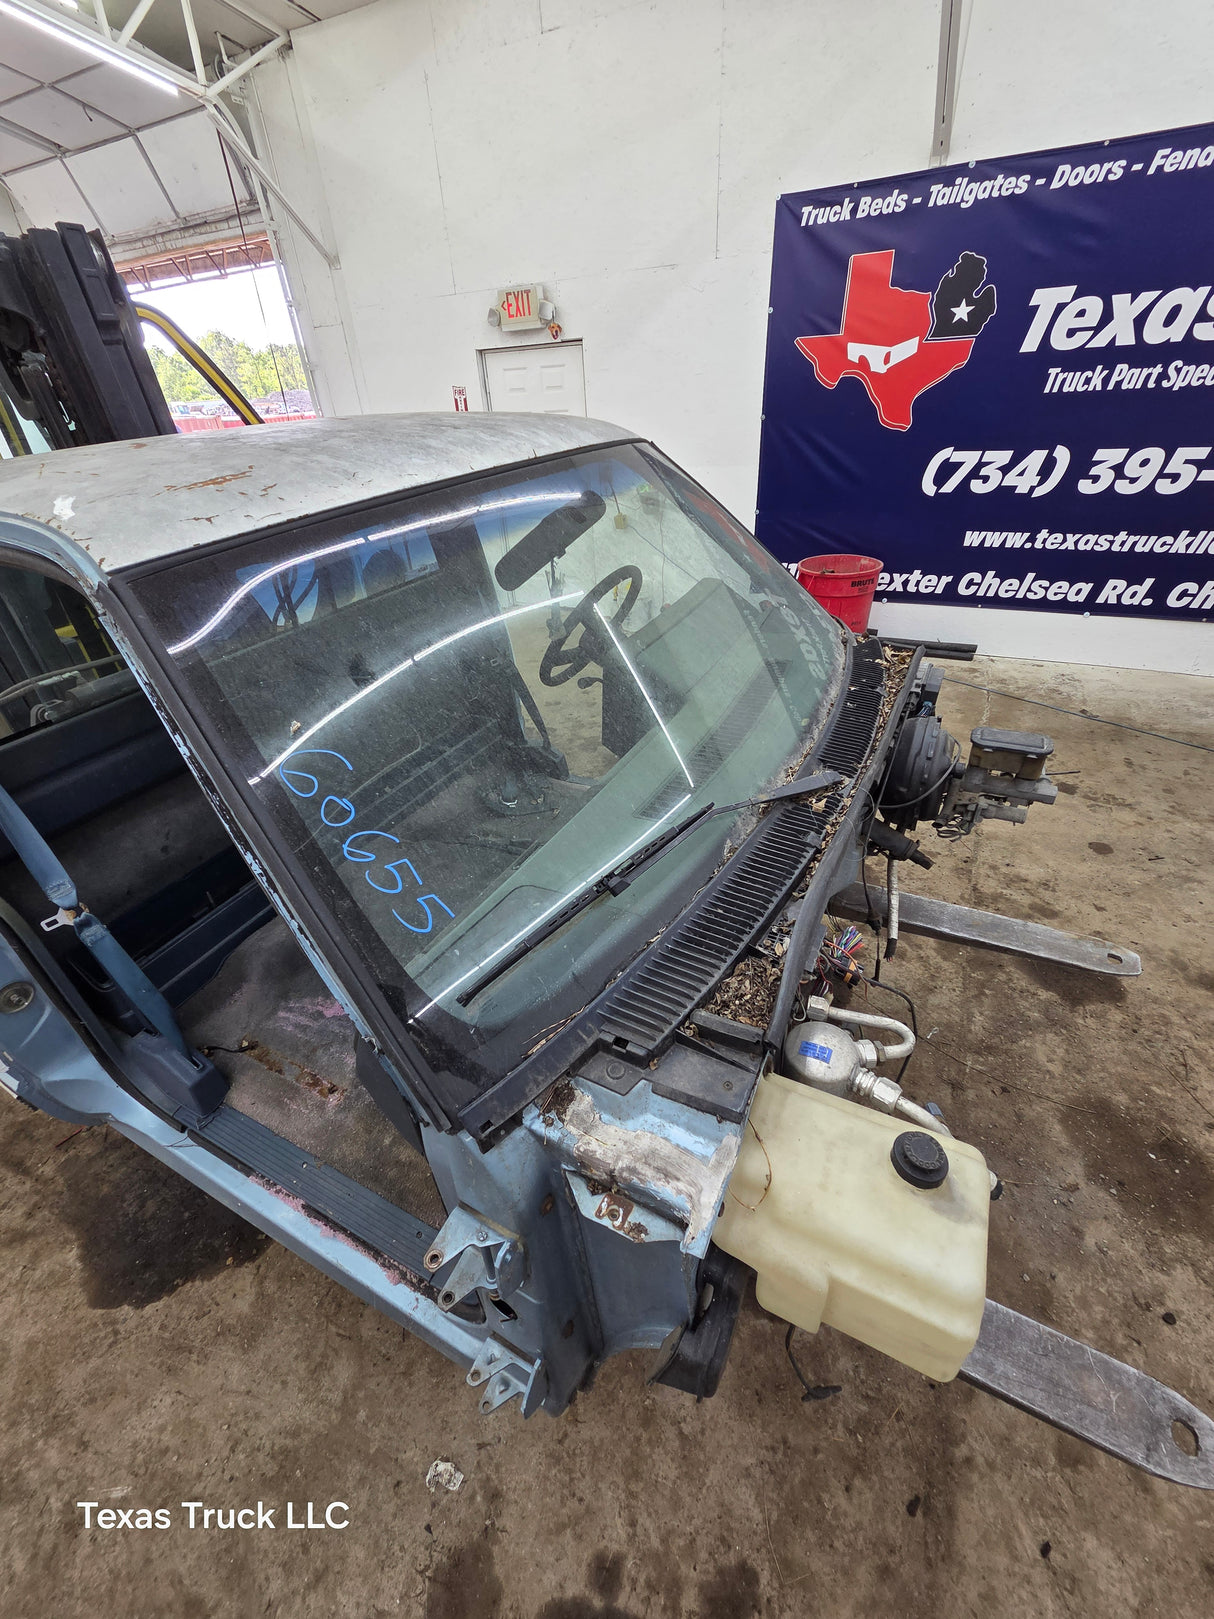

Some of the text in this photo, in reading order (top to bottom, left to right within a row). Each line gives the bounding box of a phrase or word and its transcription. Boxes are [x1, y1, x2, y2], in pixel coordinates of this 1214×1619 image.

[800, 197, 855, 227] Truck
[855, 188, 909, 220] Beds
[927, 173, 1031, 209] Tailgates
[1049, 159, 1128, 190] Doors
[505, 289, 532, 319] EXIT
[1043, 364, 1109, 394] Truck
[1107, 363, 1164, 392] Part
[921, 444, 1071, 498] (734)
[874, 569, 954, 595] exter
[957, 570, 1094, 603] Chelsea
[1095, 577, 1156, 606] Rd.
[279, 748, 456, 934] 60655
